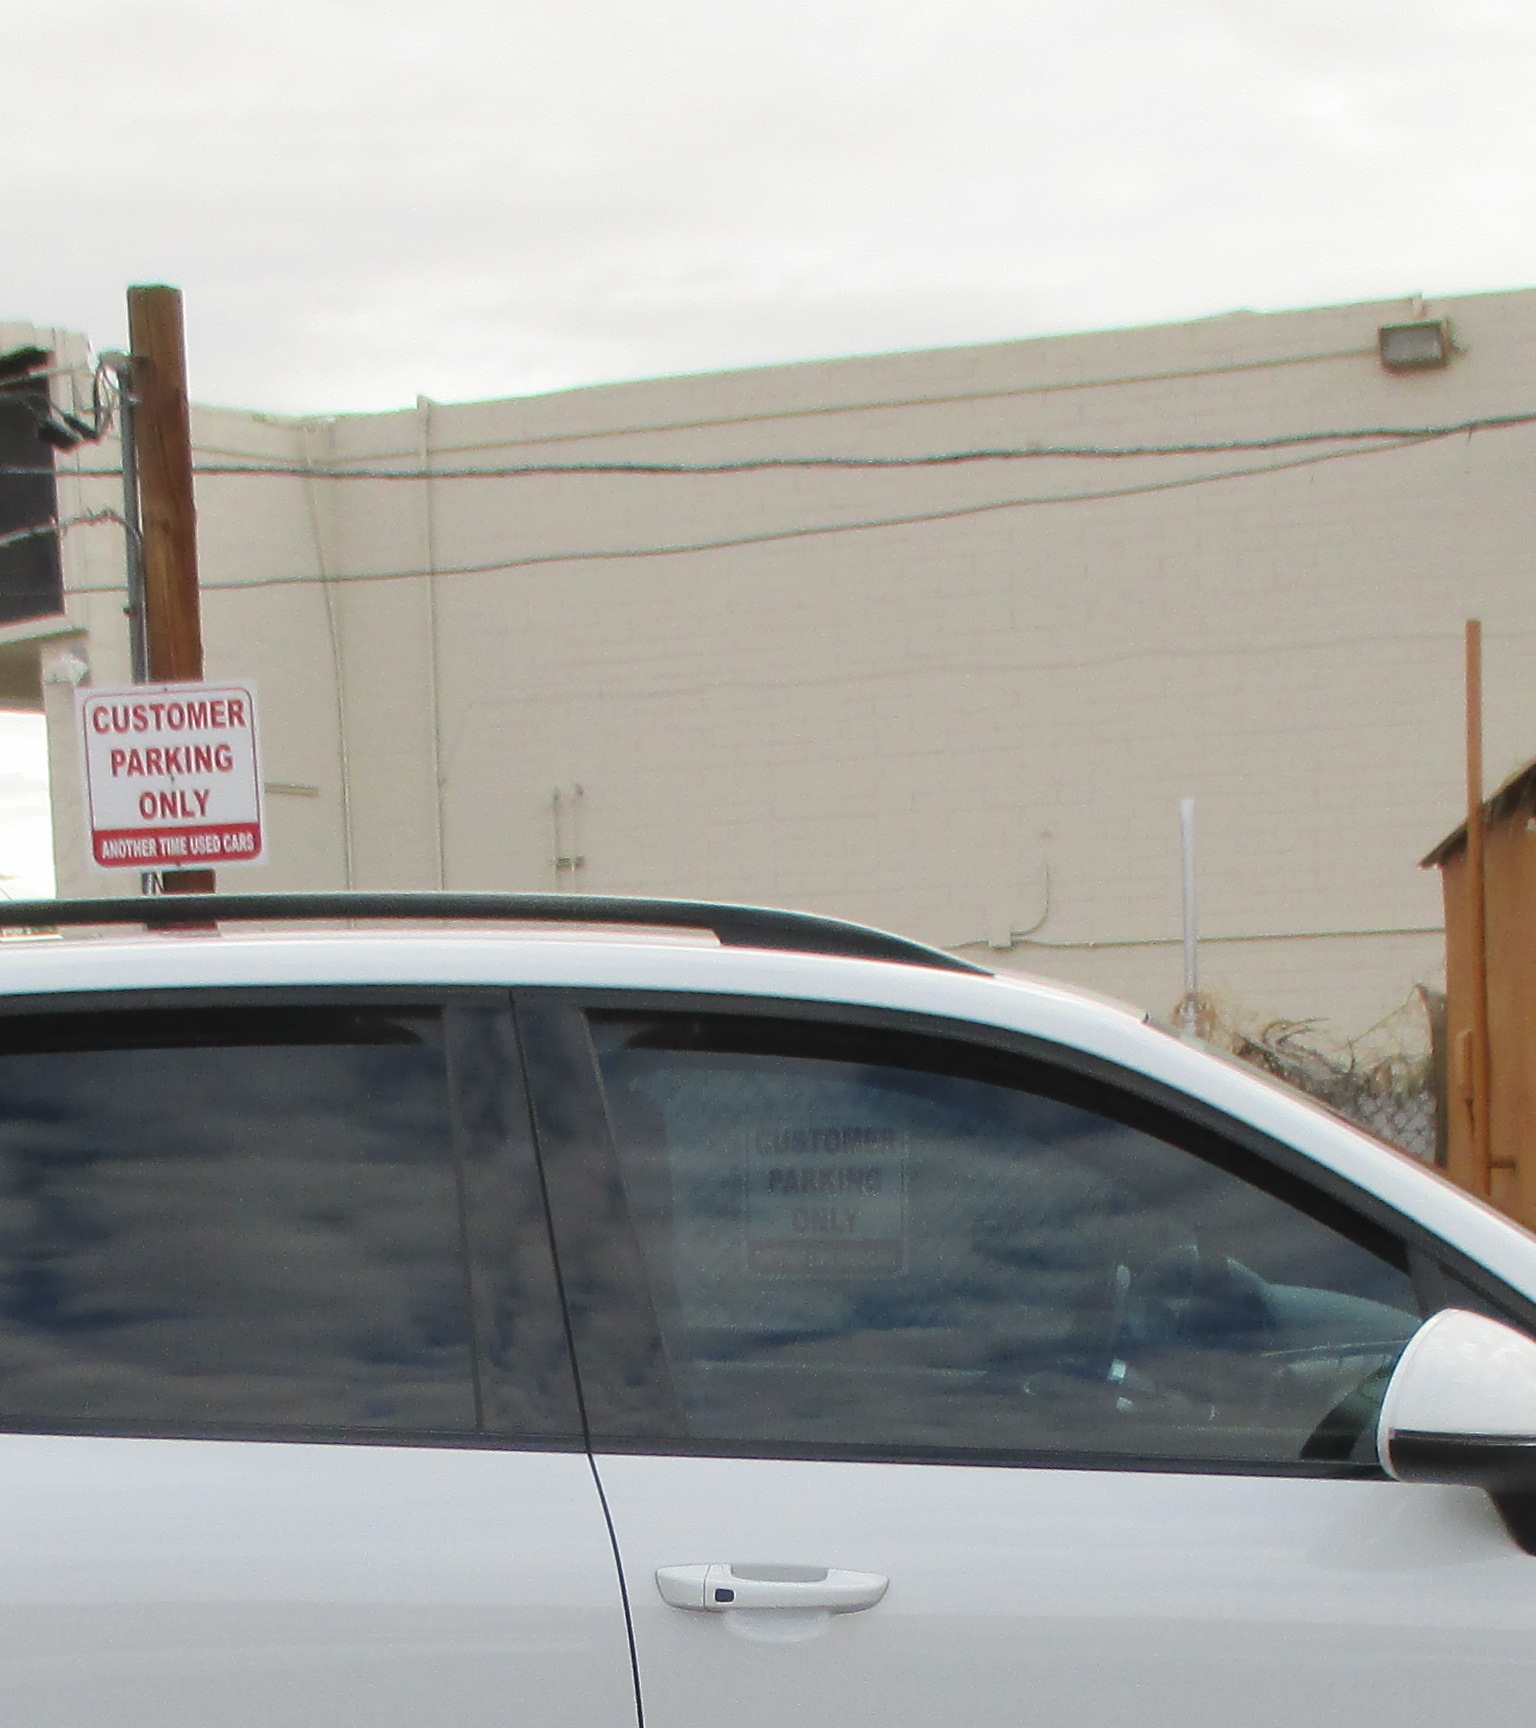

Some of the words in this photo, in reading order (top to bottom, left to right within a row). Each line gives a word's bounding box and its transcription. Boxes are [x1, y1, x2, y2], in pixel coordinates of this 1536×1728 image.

[93, 699, 247, 735] CUSTOMER
[110, 744, 234, 778] PARKING
[139, 788, 211, 820] ONLY
[102, 838, 158, 859] ANOTHER
[159, 836, 188, 857] TIME
[190, 834, 221, 855] USED
[223, 832, 254, 853] CARS
[756, 1126, 896, 1154] CUSTOMER
[768, 1167, 882, 1194] PARKING
[791, 1207, 858, 1233] ONLY
